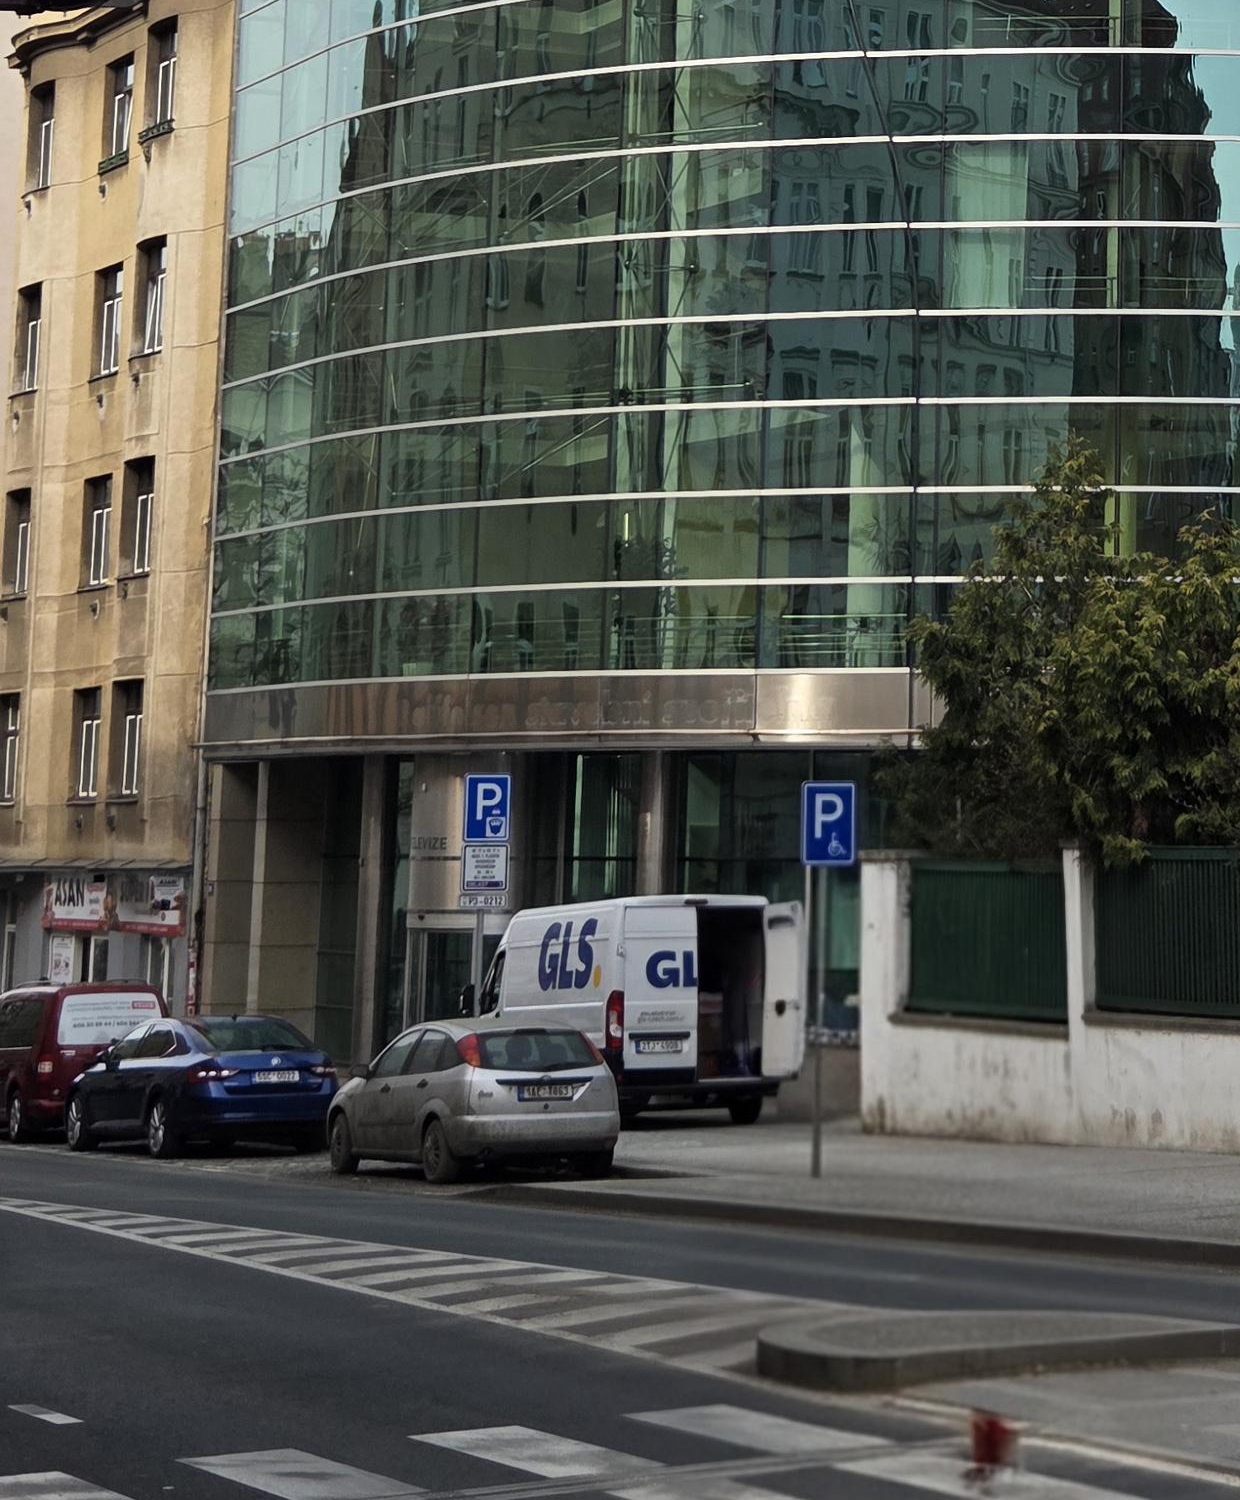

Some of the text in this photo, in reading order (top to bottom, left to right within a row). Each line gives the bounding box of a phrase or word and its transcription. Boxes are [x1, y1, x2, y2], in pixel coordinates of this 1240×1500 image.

[475, 782, 503, 821] P
[814, 792, 844, 839] P
[54, 876, 86, 907] ASAN
